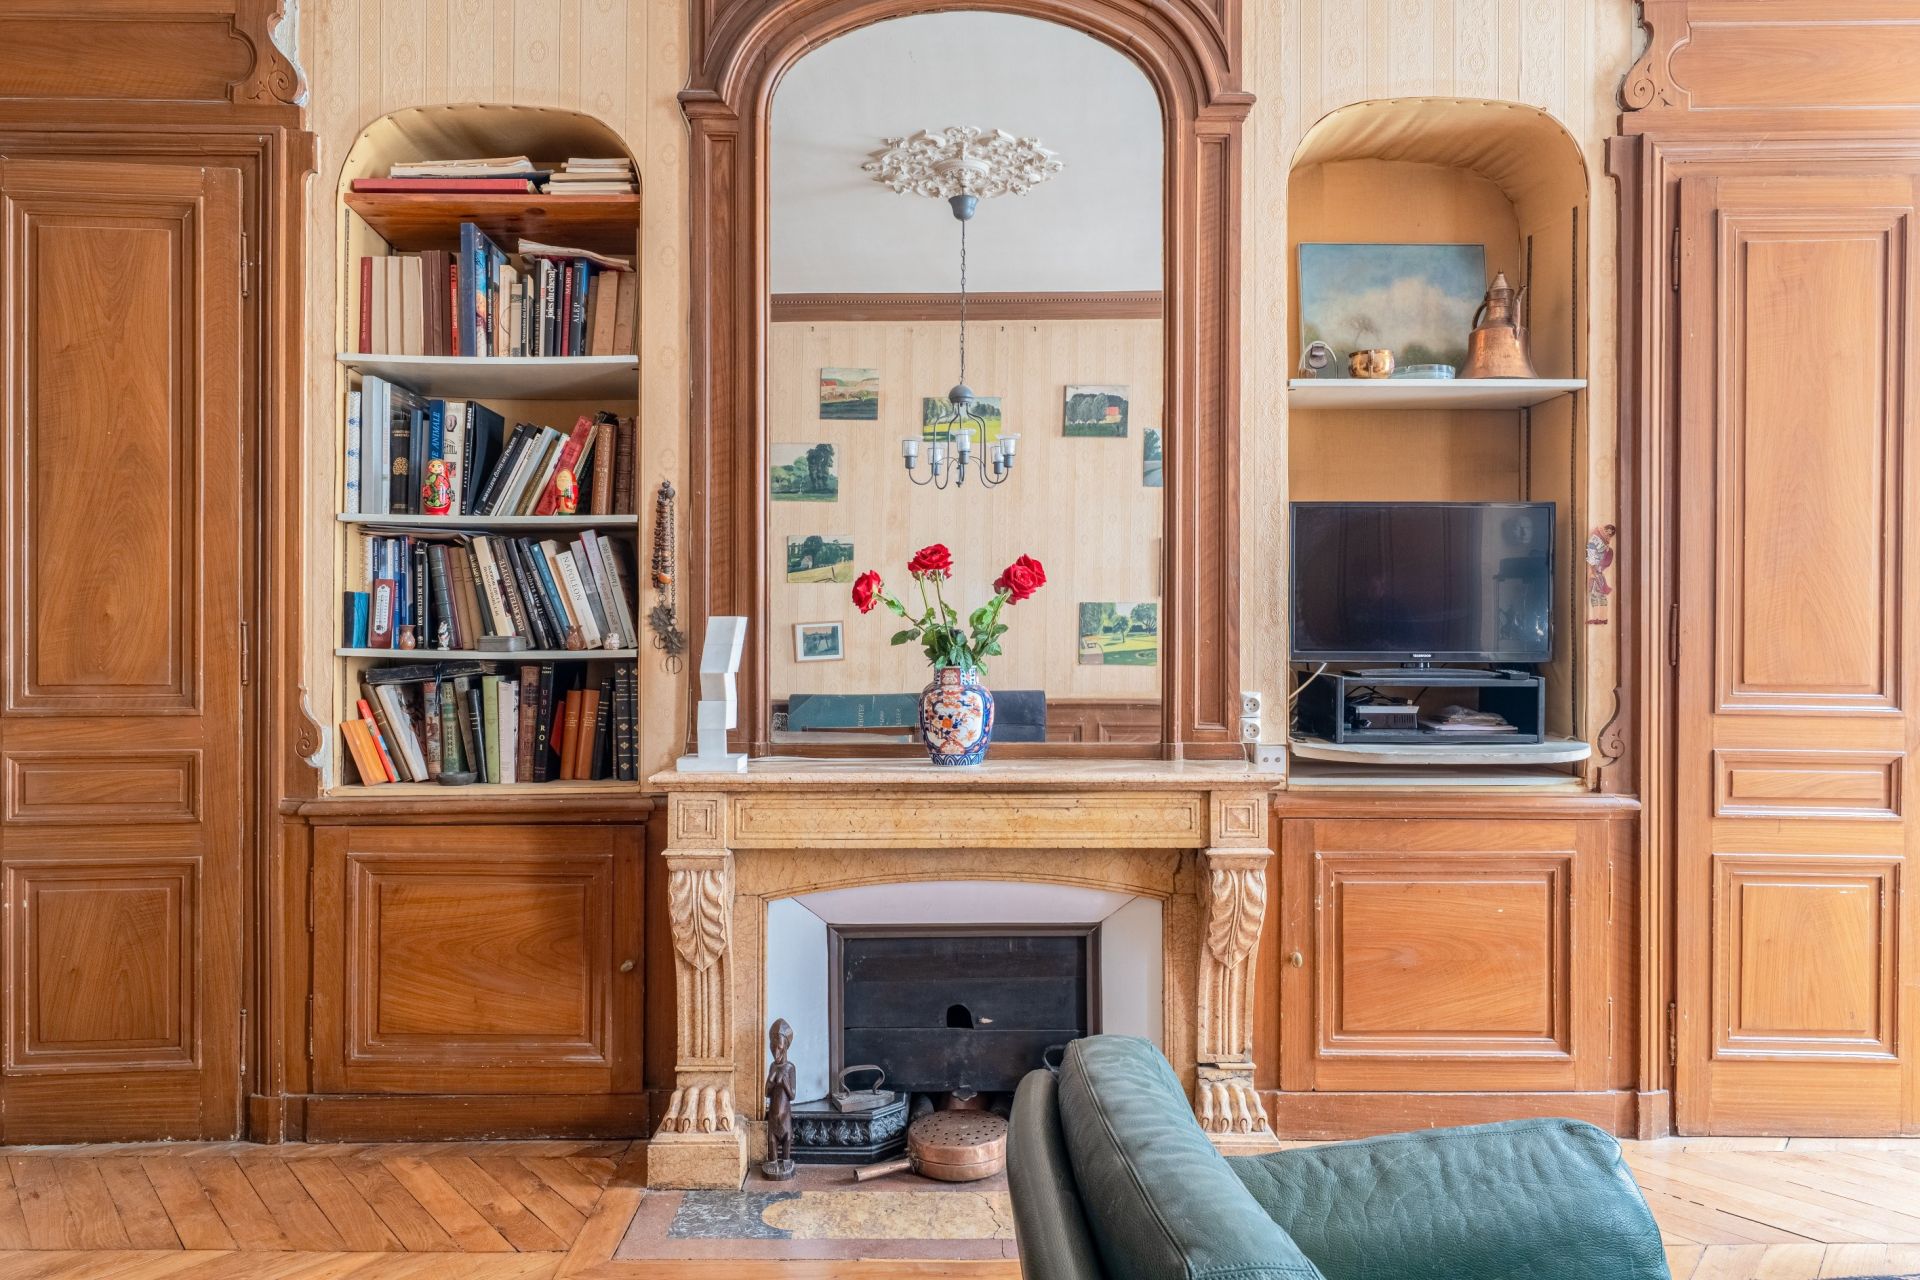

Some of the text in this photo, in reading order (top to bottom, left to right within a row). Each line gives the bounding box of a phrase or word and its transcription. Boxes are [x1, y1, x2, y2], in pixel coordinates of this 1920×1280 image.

[546, 292, 555, 302] du
[431, 411, 440, 449] ANIMALE
[507, 587, 525, 631] IMMORTELLE
